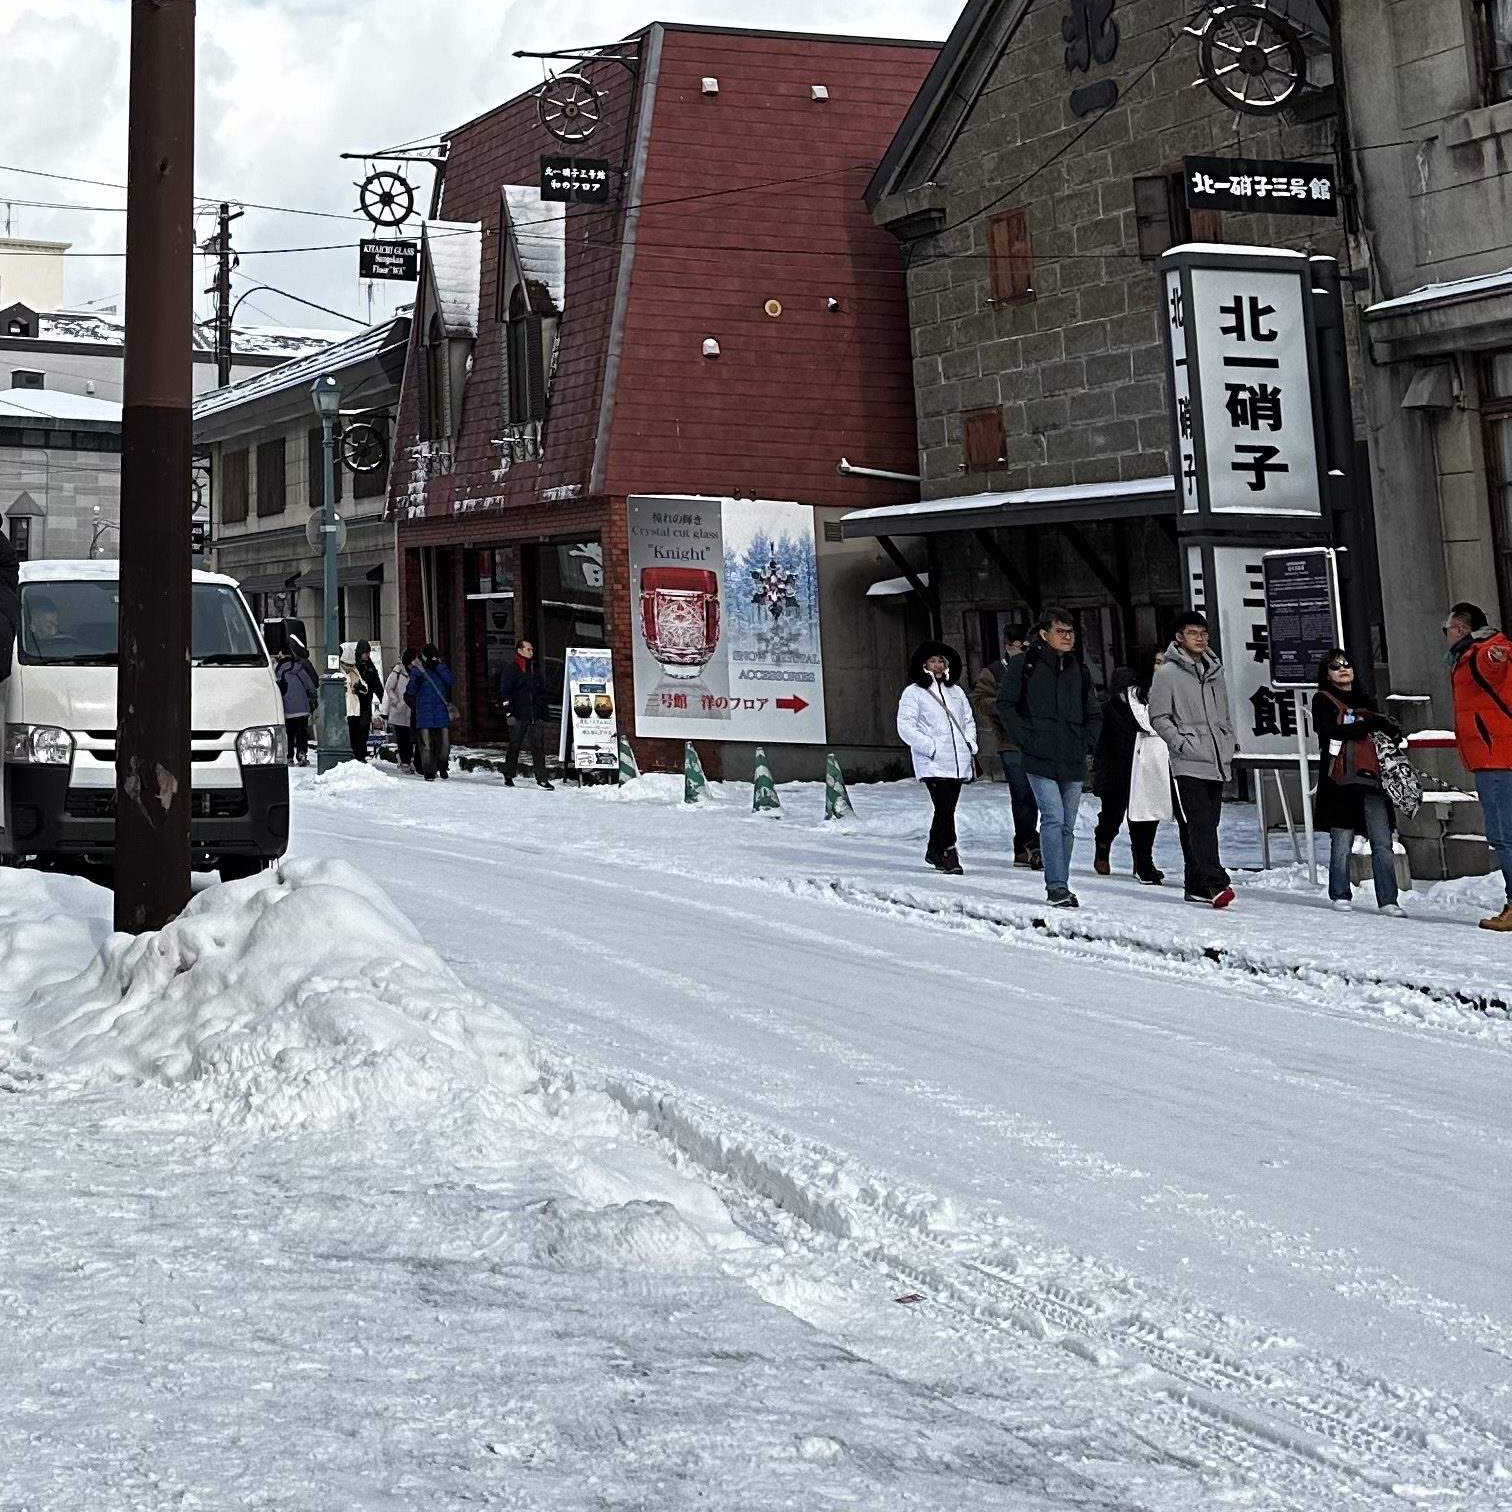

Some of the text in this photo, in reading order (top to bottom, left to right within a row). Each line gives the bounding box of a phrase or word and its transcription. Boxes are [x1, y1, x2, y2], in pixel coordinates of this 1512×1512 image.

[1192, 172, 1331, 200] 北一硝子三号館
[1220, 295, 1289, 491] 北一硝子
[632, 525, 719, 539] Crystal cut glass
[732, 650, 767, 661] SNOW
[647, 693, 769, 711] 三号館 洋のフロア
